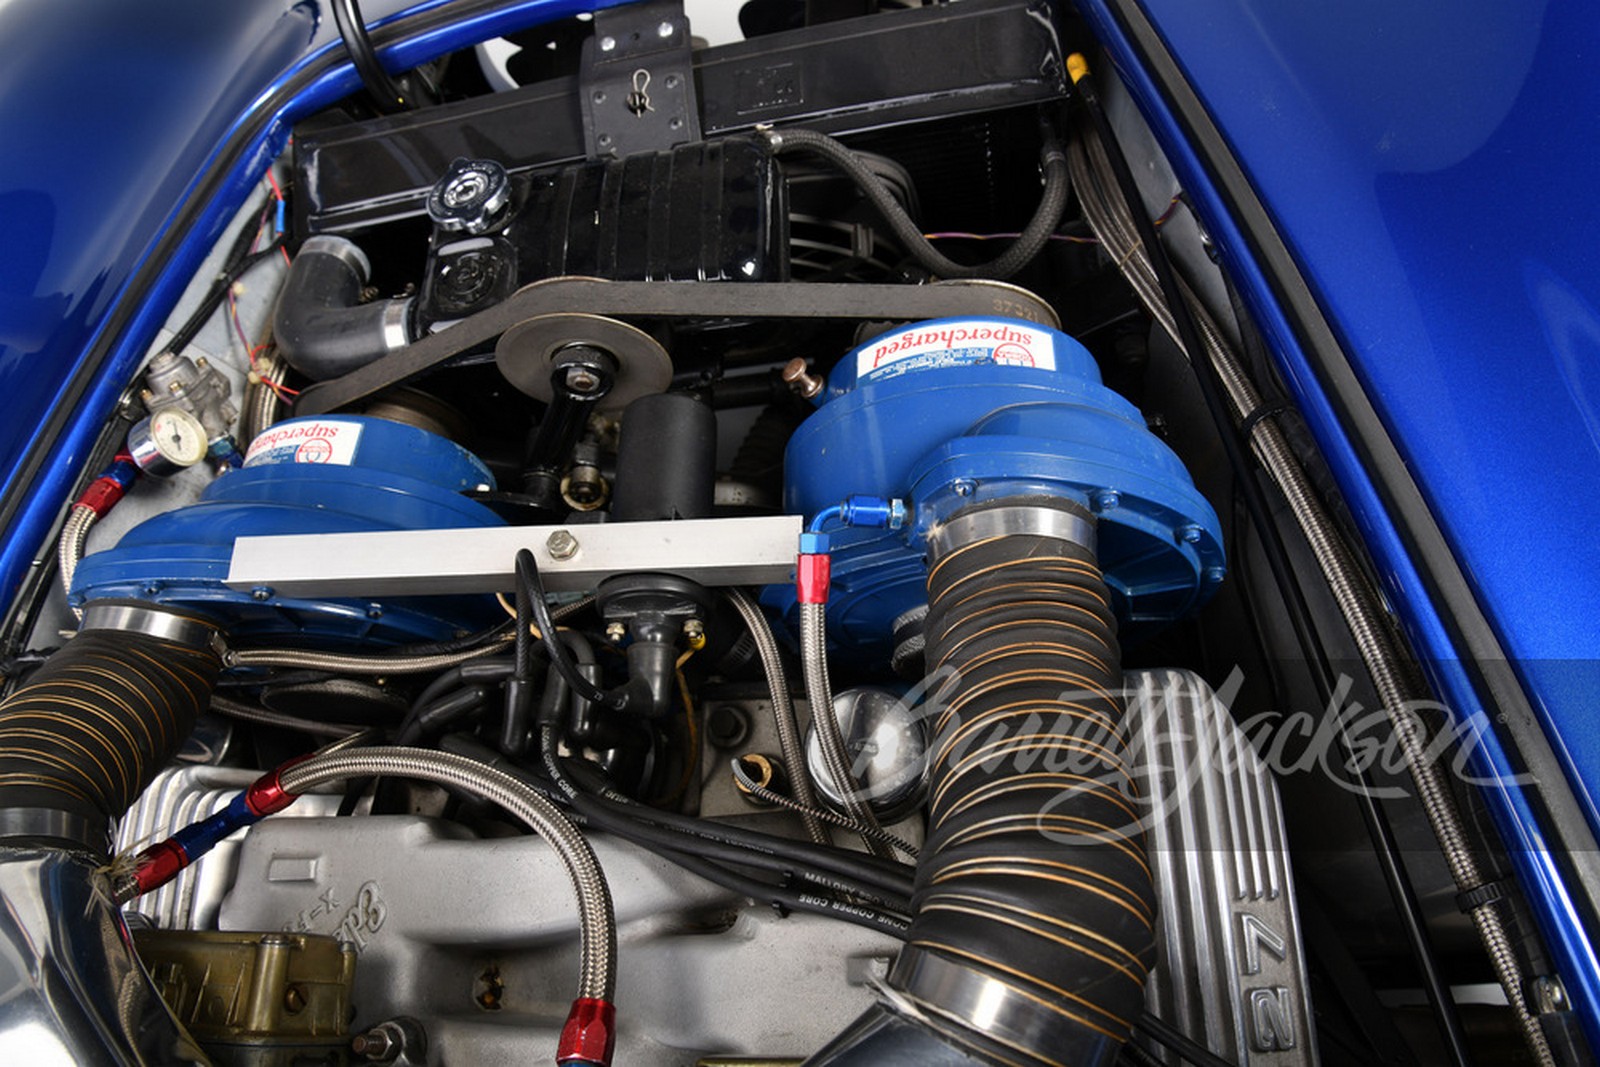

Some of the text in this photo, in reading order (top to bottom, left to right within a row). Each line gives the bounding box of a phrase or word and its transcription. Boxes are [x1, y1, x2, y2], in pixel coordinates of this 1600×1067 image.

[872, 326, 1033, 369] supercharged
[557, 779, 579, 800] CORE
[804, 872, 856, 894] MALLORY
[799, 894, 829, 908] CORE
[832, 901, 875, 920] COPPER
